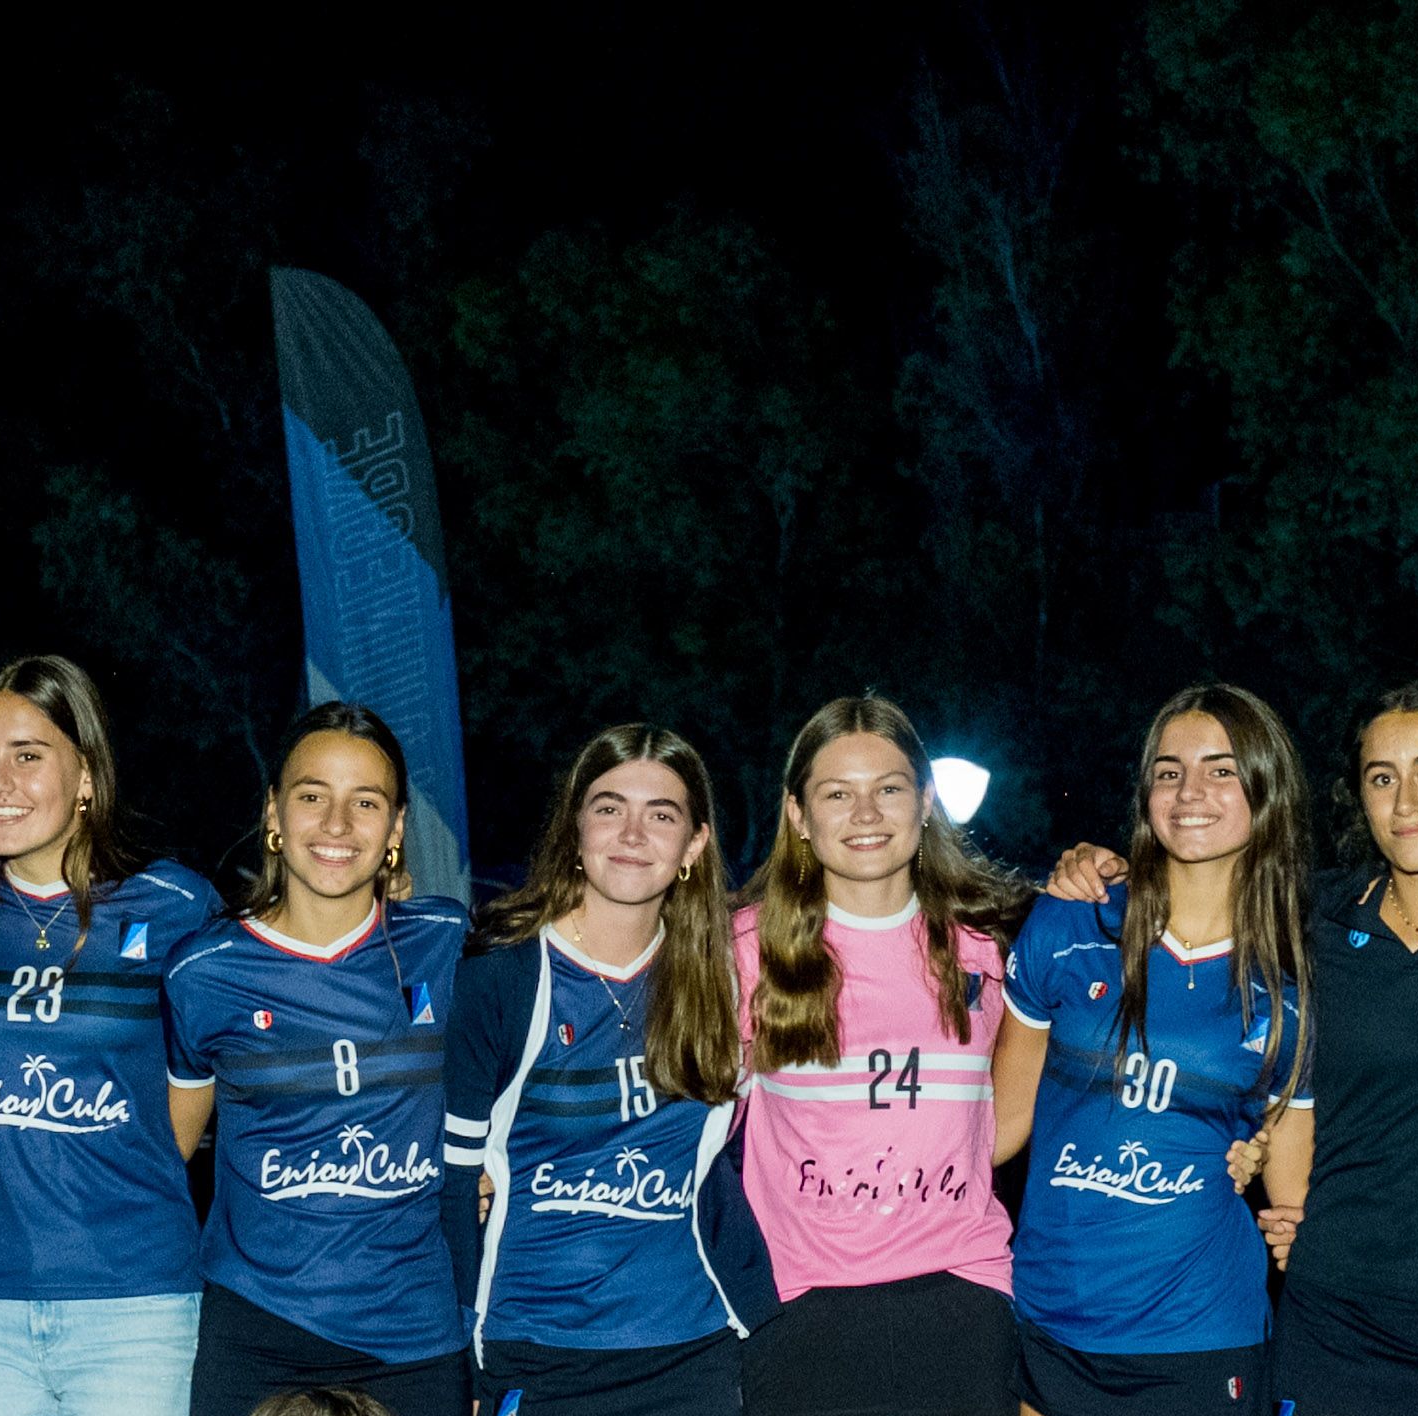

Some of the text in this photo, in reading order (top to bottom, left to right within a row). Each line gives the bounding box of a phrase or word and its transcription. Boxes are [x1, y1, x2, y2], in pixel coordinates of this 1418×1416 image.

[7, 965, 64, 1023] 23
[332, 1039, 360, 1096] 8
[615, 1055, 657, 1122] 15
[868, 1046, 922, 1110] 24
[1121, 1052, 1177, 1113] 30
